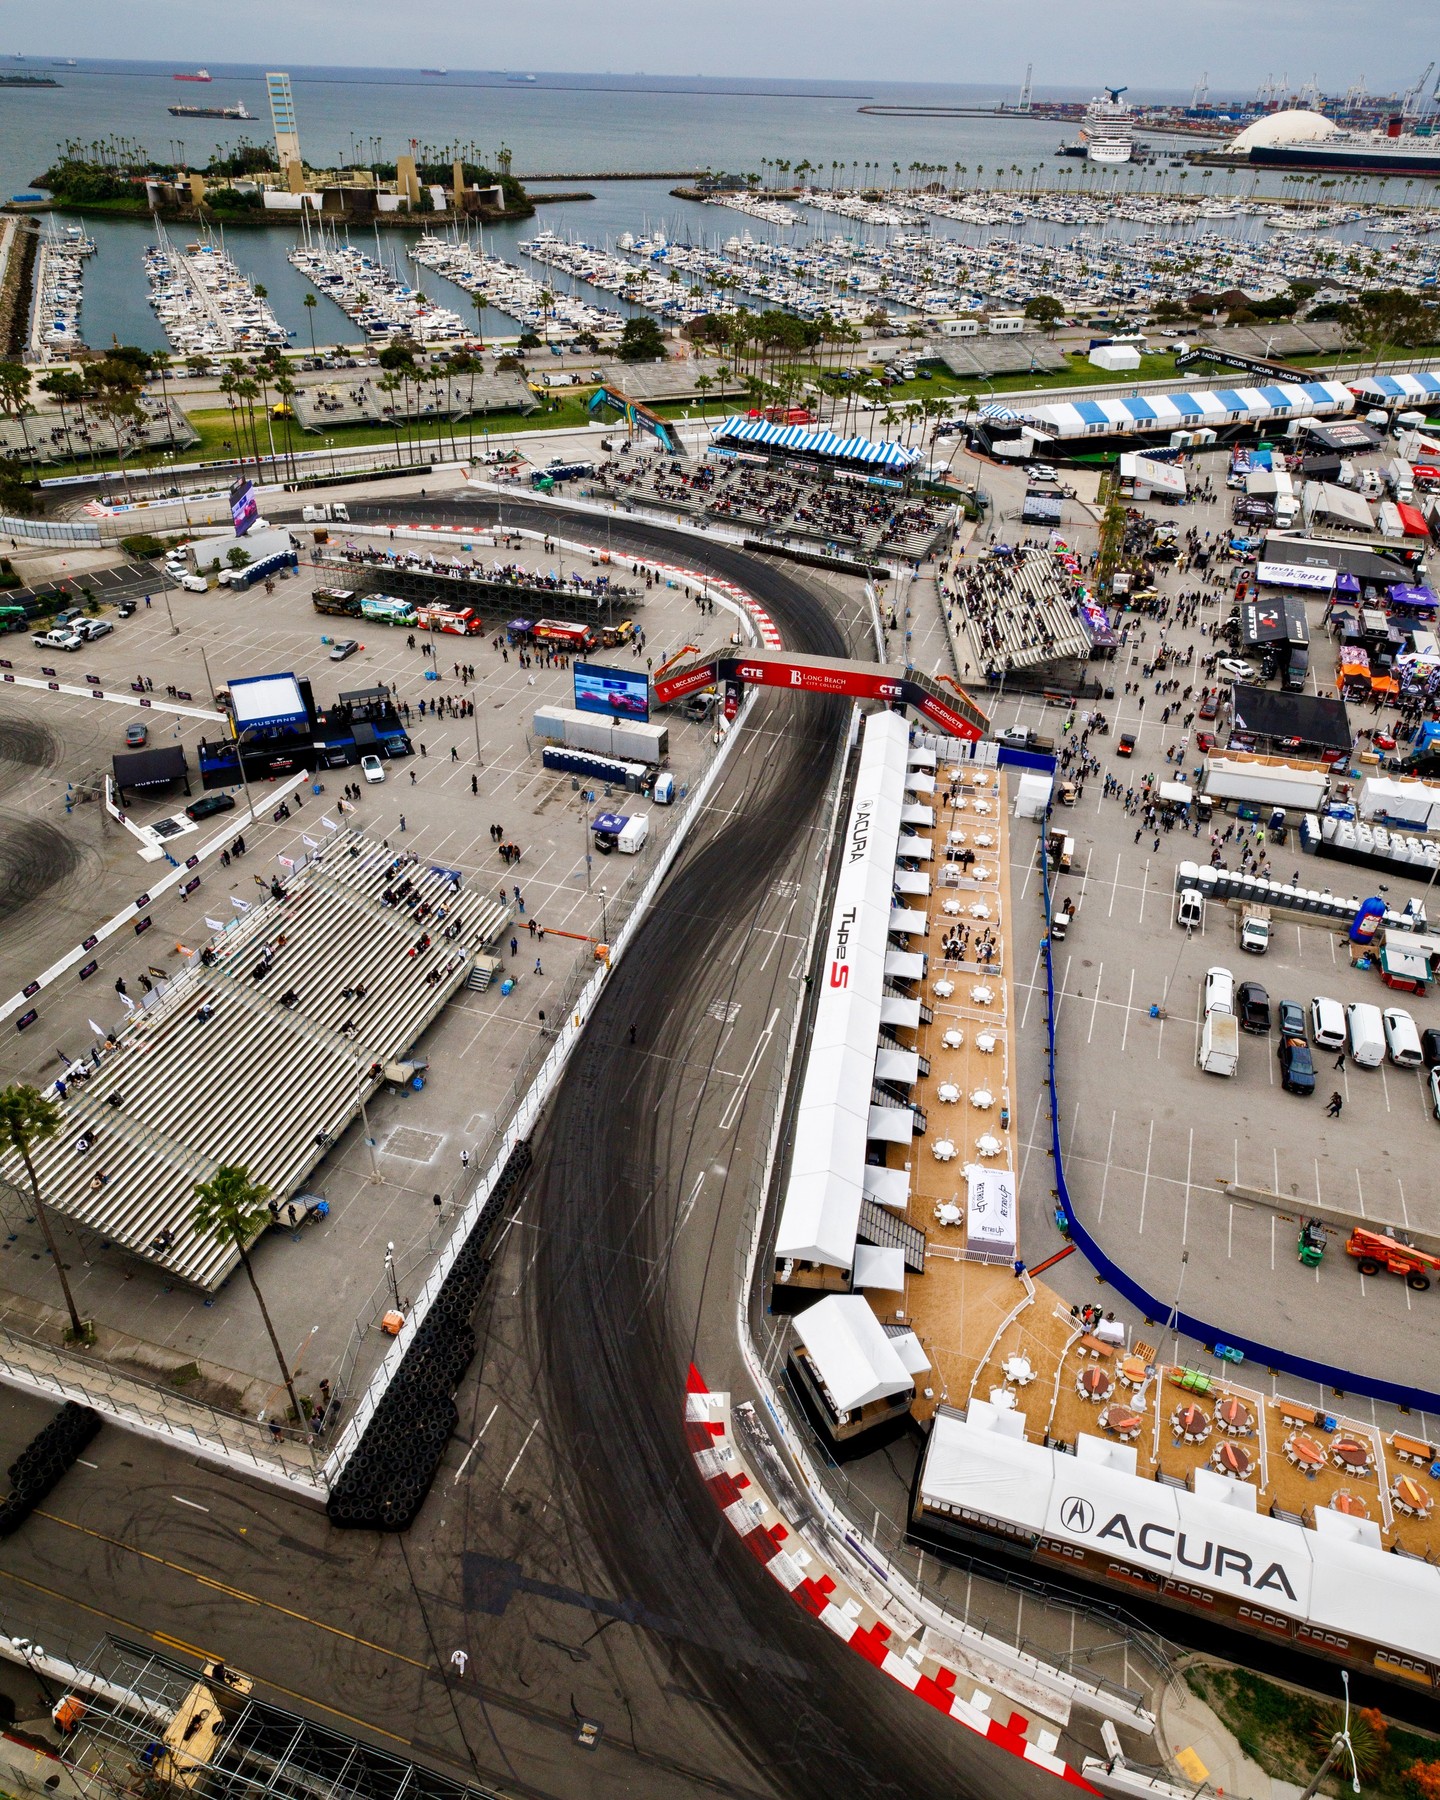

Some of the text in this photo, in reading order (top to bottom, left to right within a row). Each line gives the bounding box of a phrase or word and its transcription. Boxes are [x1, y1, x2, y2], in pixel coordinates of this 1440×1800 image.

[1181, 350, 1200, 363] ACURA
[1204, 352, 1222, 362] ACURA
[1229, 359, 1247, 369] ACURA
[1255, 366, 1274, 376] ACURA
[1282, 373, 1302, 383] ACURA
[450, 569, 458, 578] 21
[1286, 570, 1328, 581] PURPLE
[1079, 649, 1089, 659] 16
[741, 667, 764, 678] CTE
[672, 669, 713, 689] LBCC.EDU/CTE
[802, 673, 847, 685] LONG BEACH
[819, 682, 842, 690] COLLEGE
[879, 684, 903, 695] CTE
[924, 698, 964, 729] LBCC.EDU/CTE
[250, 716, 297, 727] MUSTANG
[134, 778, 170, 787] MUSTANG
[849, 812, 870, 864] ACURA
[830, 961, 849, 989] S
[1096, 1513, 1298, 1602] ACURA
